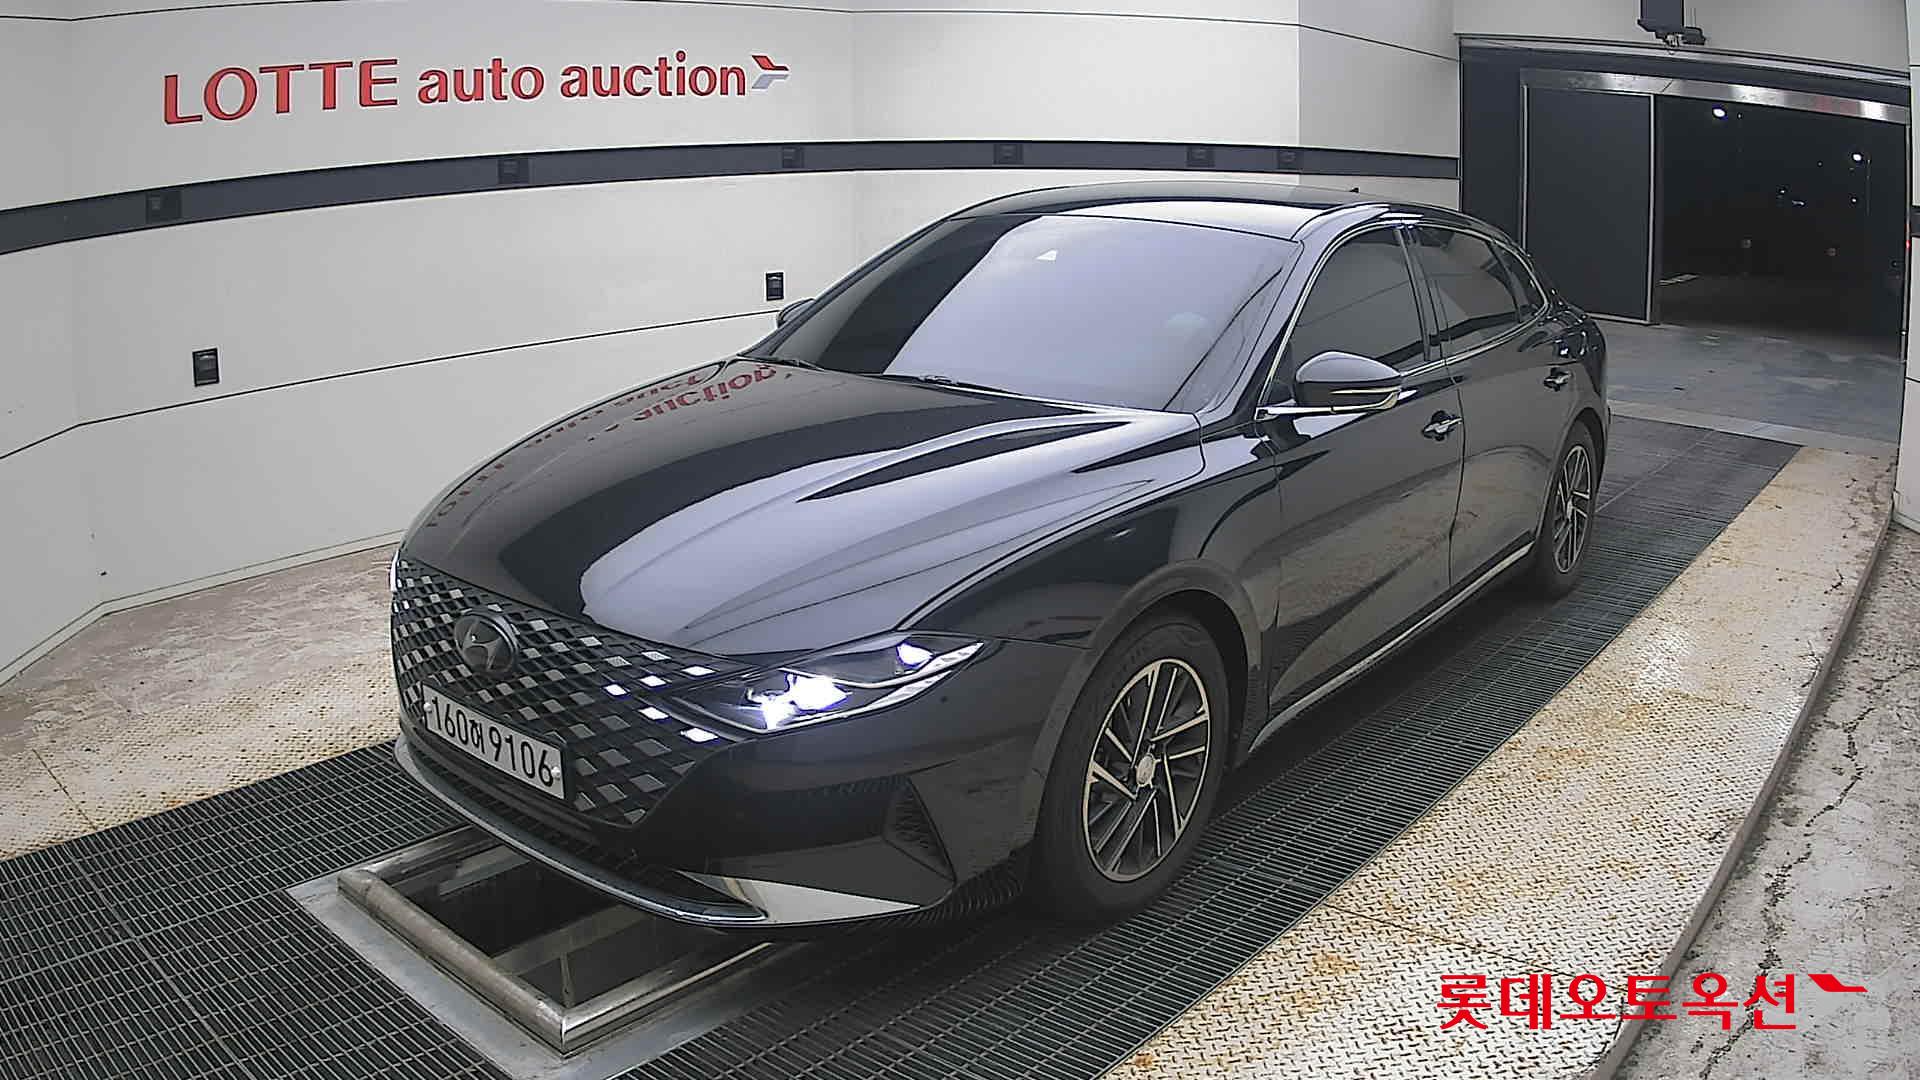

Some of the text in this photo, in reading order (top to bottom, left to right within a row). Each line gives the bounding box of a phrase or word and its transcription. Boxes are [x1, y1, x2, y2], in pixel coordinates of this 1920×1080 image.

[163, 50, 747, 126] LOTTE auto auction
[488, 725, 554, 787] 9106
